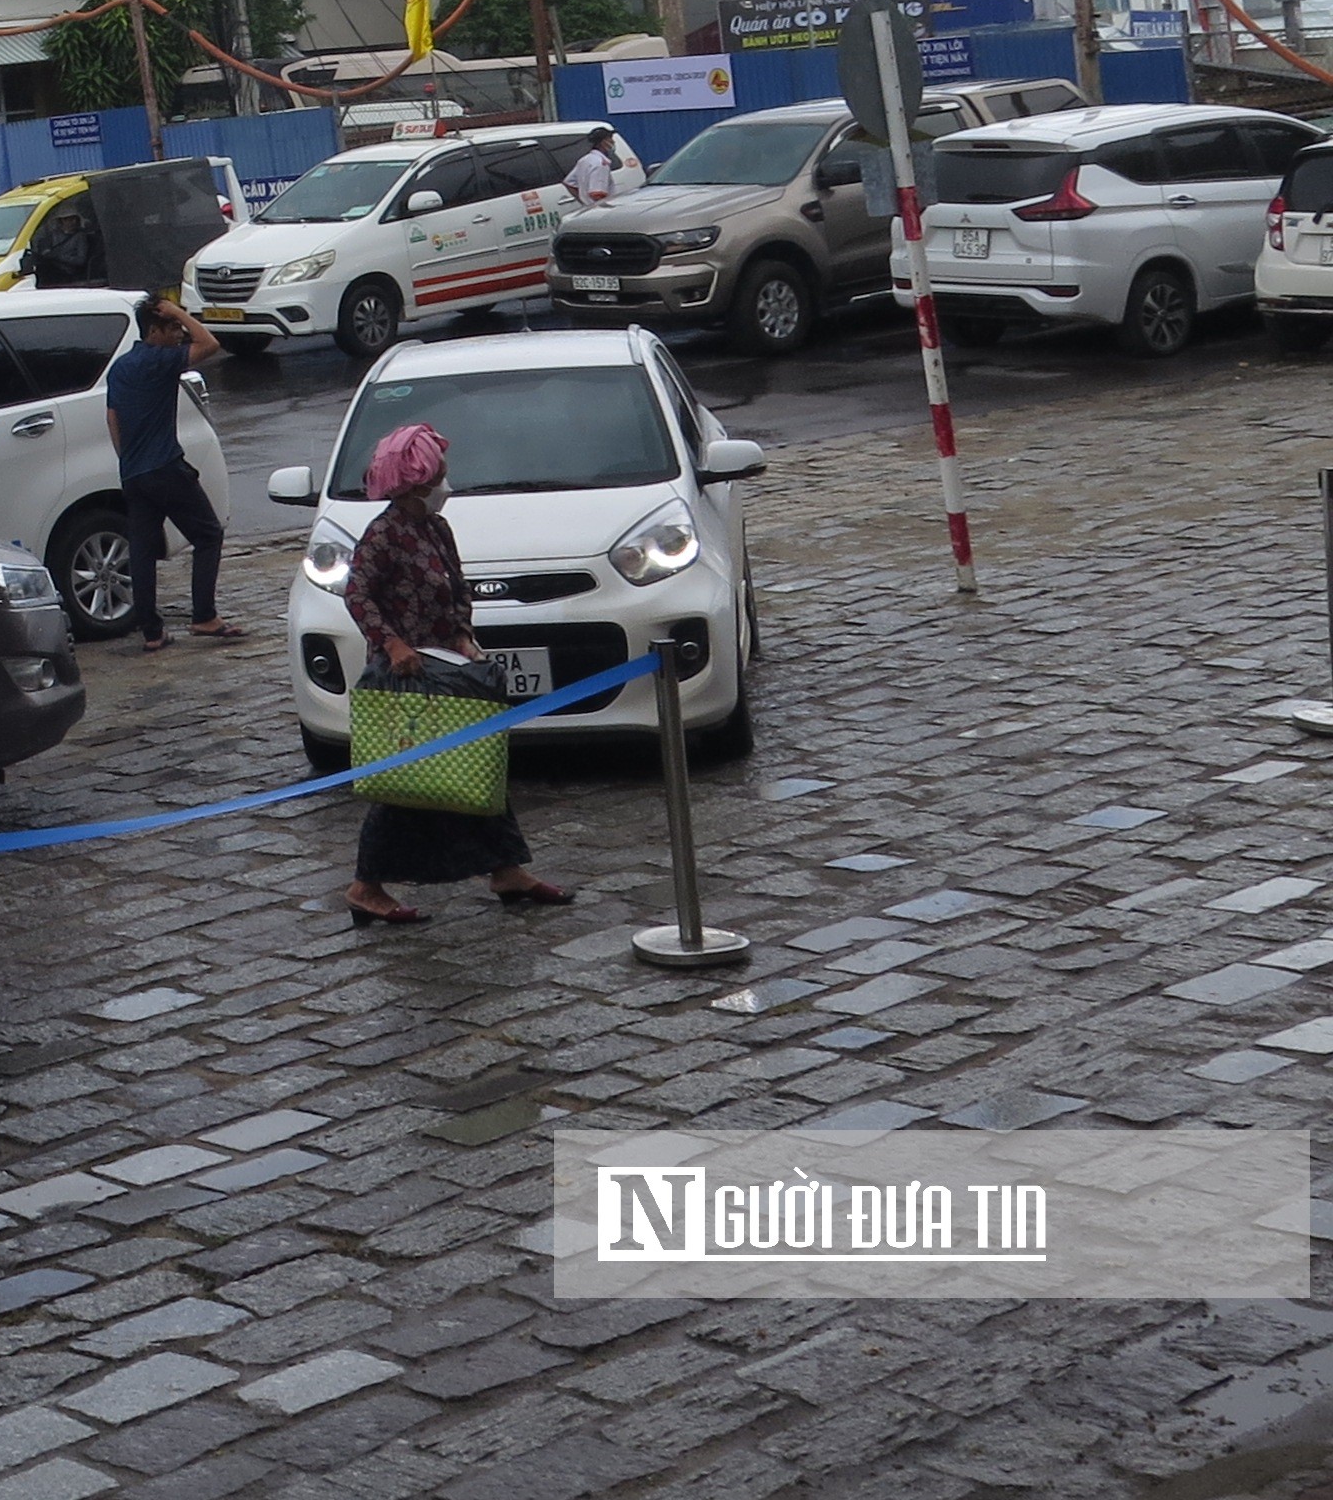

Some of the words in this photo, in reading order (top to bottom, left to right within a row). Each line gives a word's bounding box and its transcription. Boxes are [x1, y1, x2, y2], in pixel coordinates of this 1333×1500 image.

[730, 11, 769, 35] Quán
[794, 8, 828, 28] CÔ
[479, 583, 504, 594] KIA
